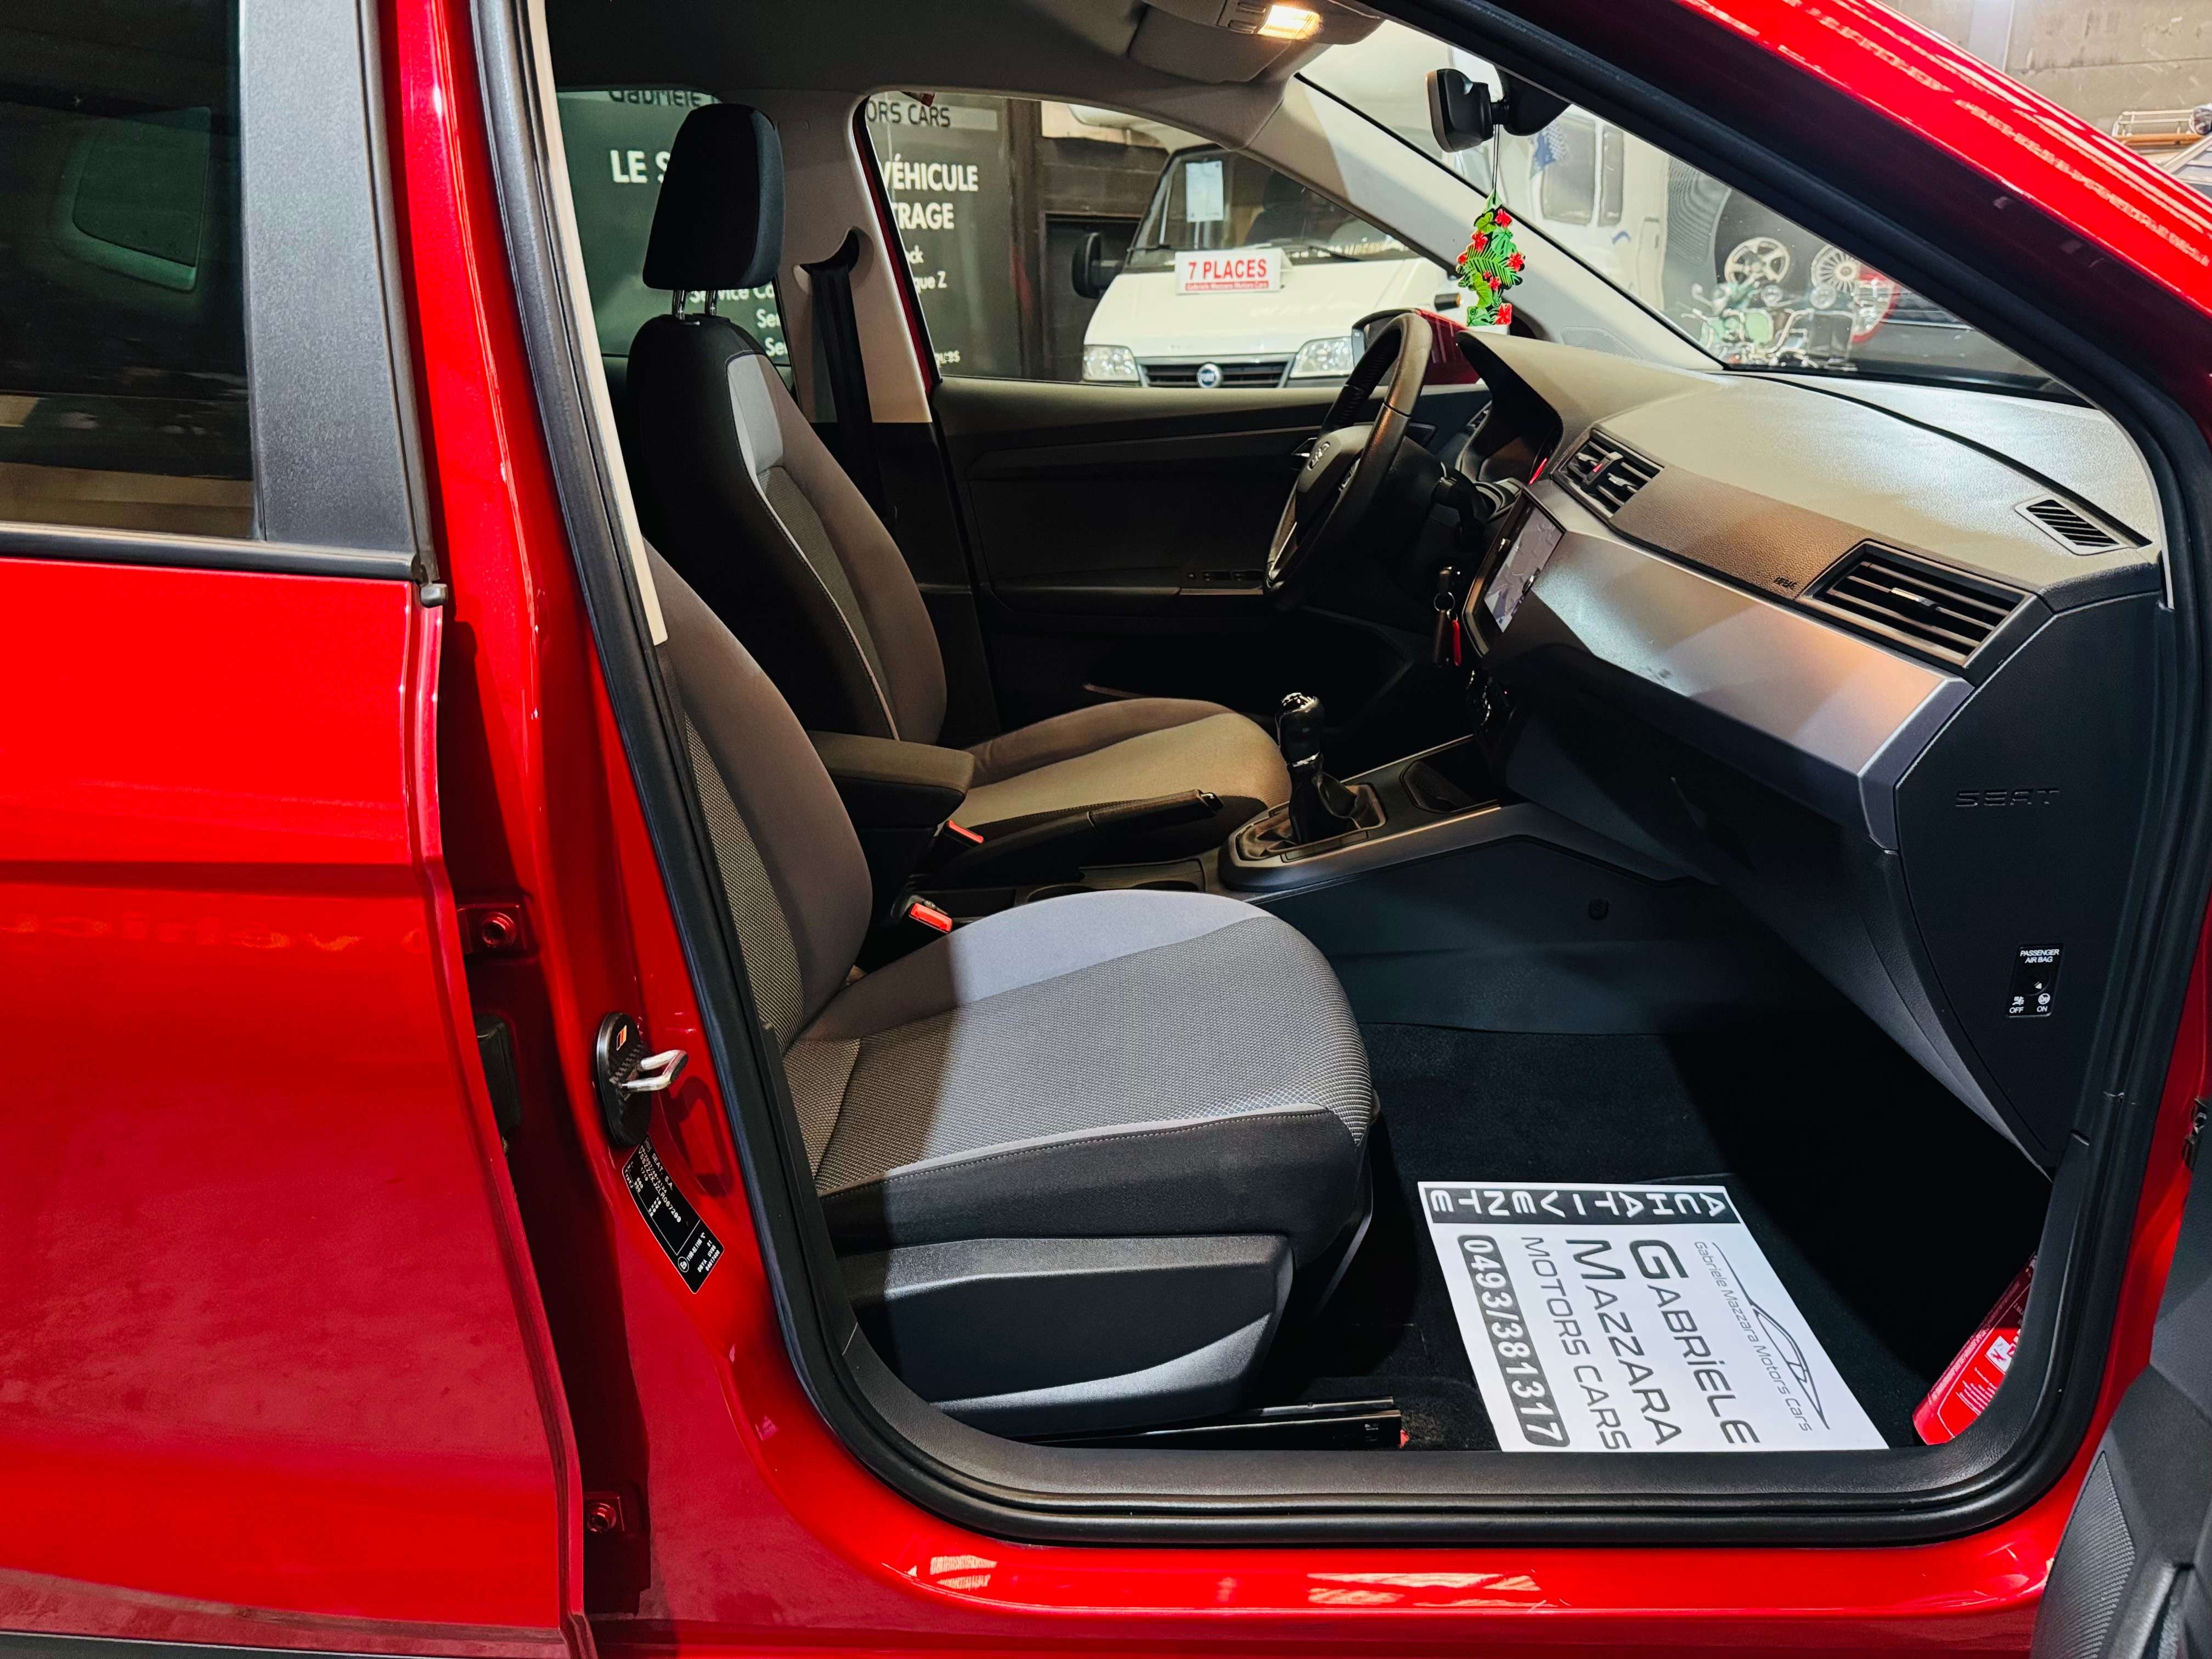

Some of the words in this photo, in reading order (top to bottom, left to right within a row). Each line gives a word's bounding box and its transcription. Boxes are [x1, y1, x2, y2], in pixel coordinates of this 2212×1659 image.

[610, 149, 648, 184] LE
[908, 104, 951, 128] CARS
[1188, 262, 1197, 280] 7
[1202, 258, 1267, 280] PLACES
[2019, 949, 2060, 957] PASSENGER
[1462, 1239, 1565, 1443] 0493/381317
[1520, 1236, 1591, 1356] MOTORS
[1573, 1365, 1632, 1450] CARS
[1565, 1238, 1683, 1446] MAZZARA
[1694, 1241, 1728, 1288] Gabriele
[1721, 1289, 1759, 1342] Mazzara
[1753, 1345, 1791, 1395] Motors
[1785, 1397, 1813, 1431] Cars
